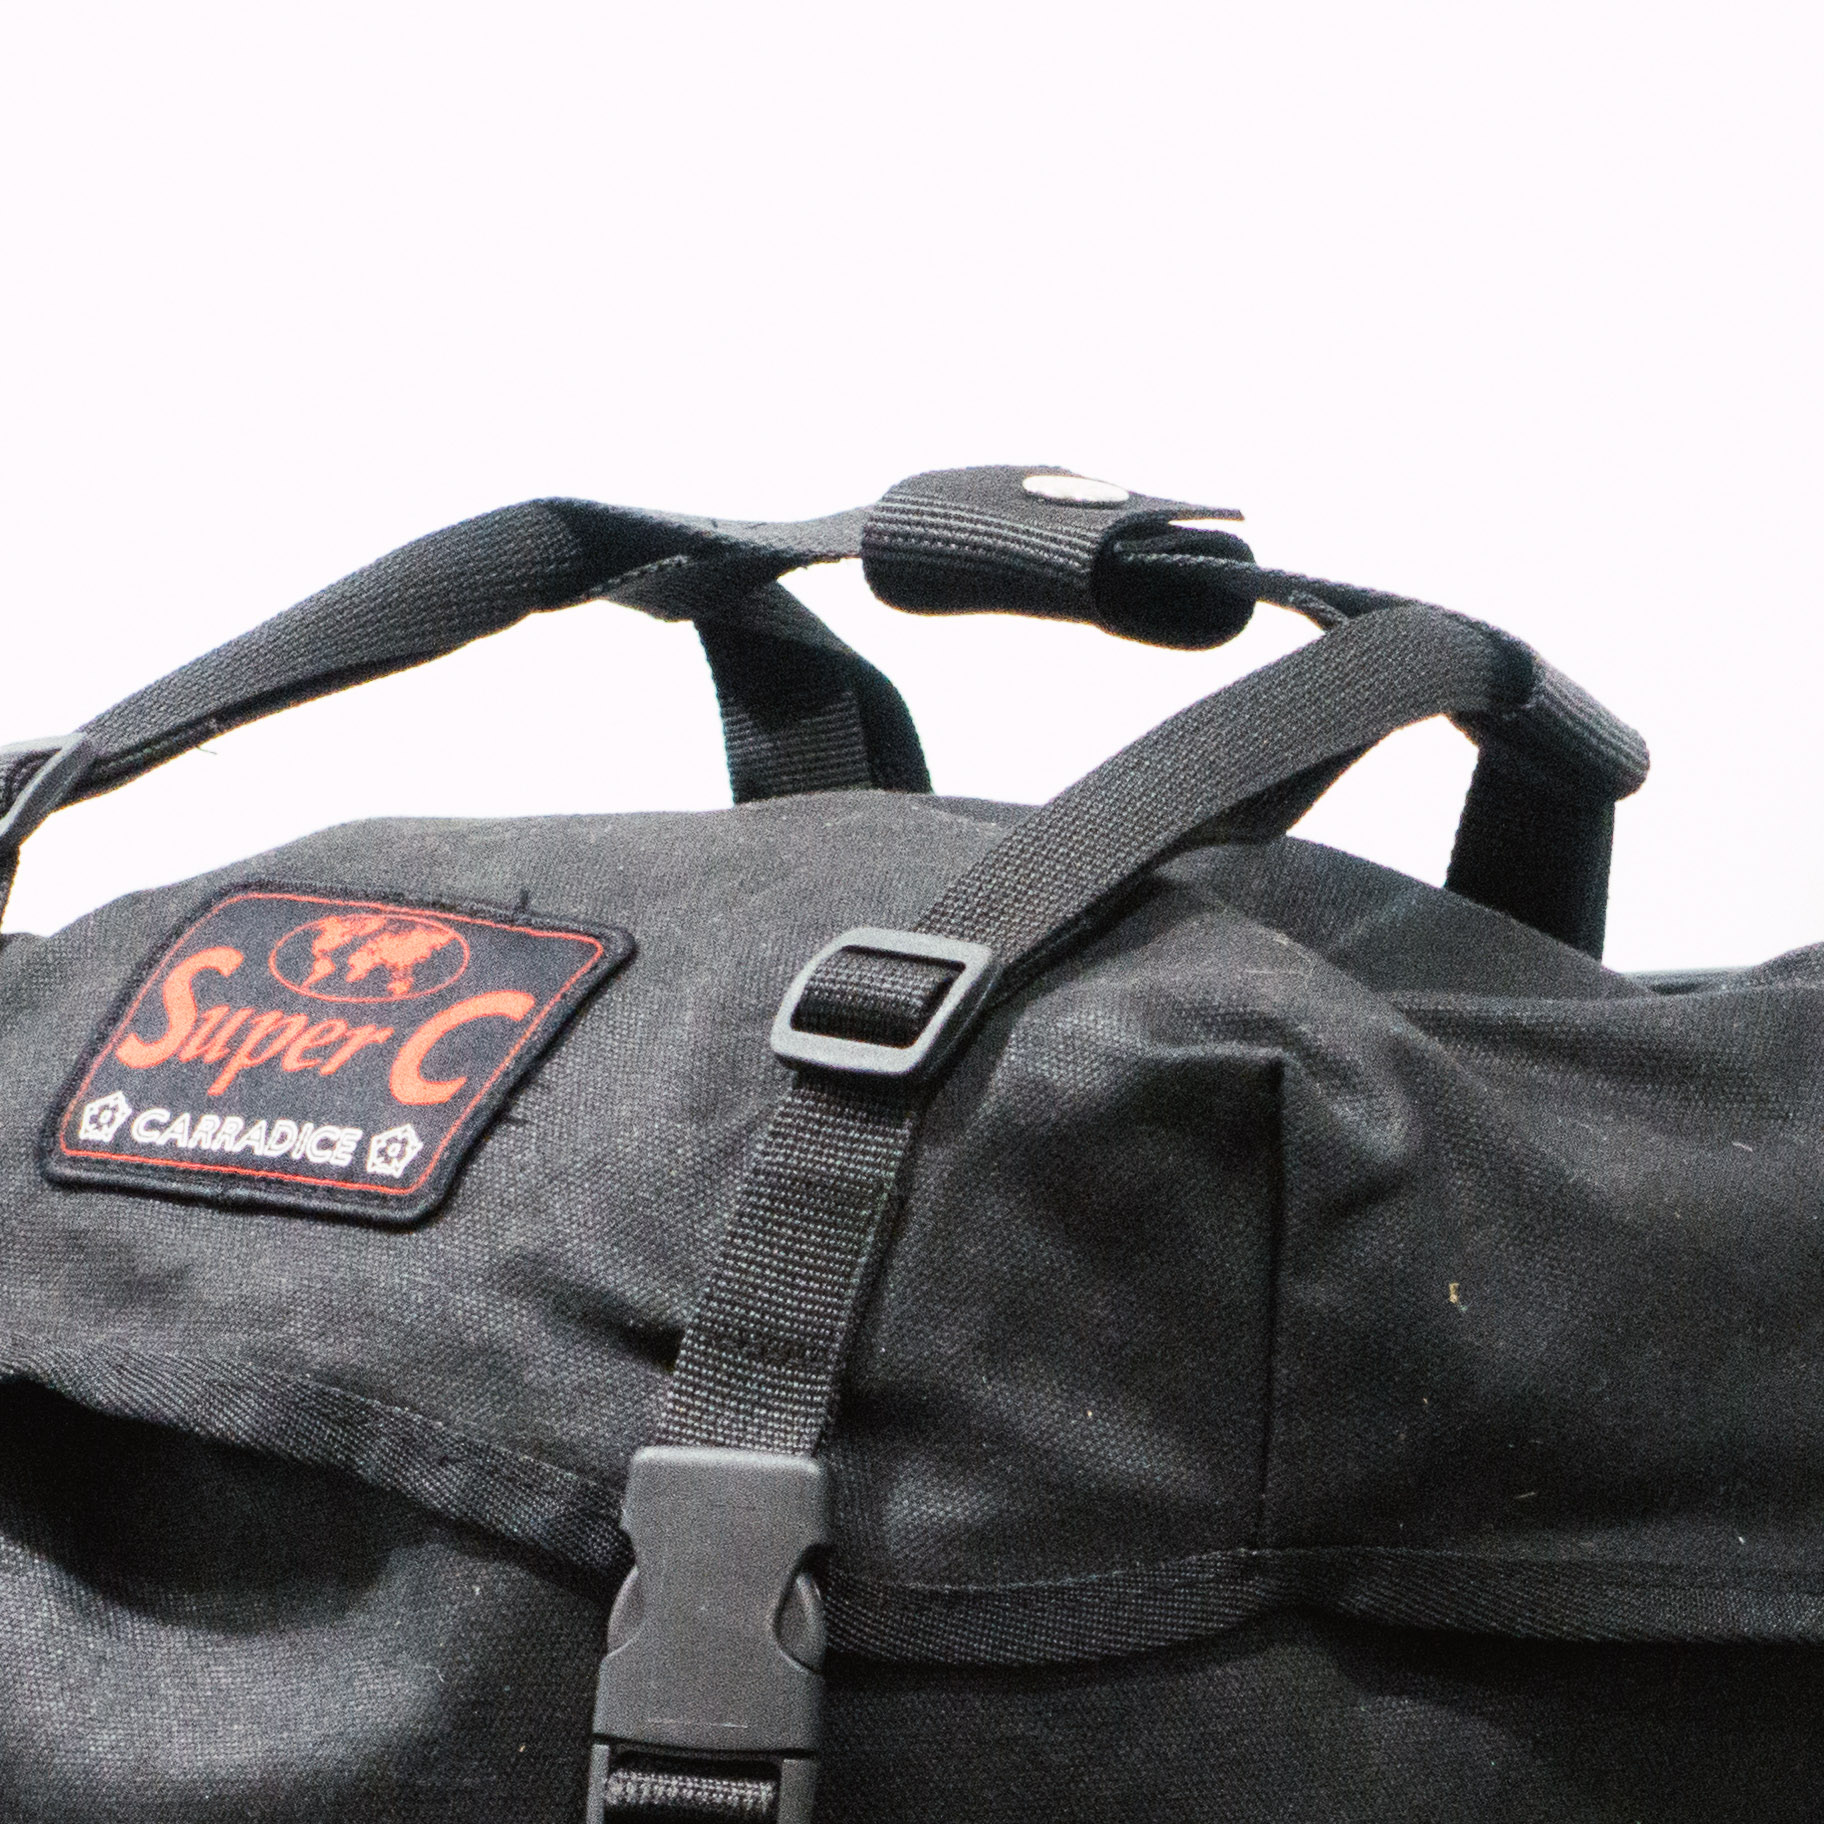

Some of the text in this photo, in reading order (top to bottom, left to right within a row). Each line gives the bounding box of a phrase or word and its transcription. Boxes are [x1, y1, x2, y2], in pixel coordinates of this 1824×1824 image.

[114, 946, 536, 1105] Super C
[130, 1108, 363, 1166] CARRADICE
